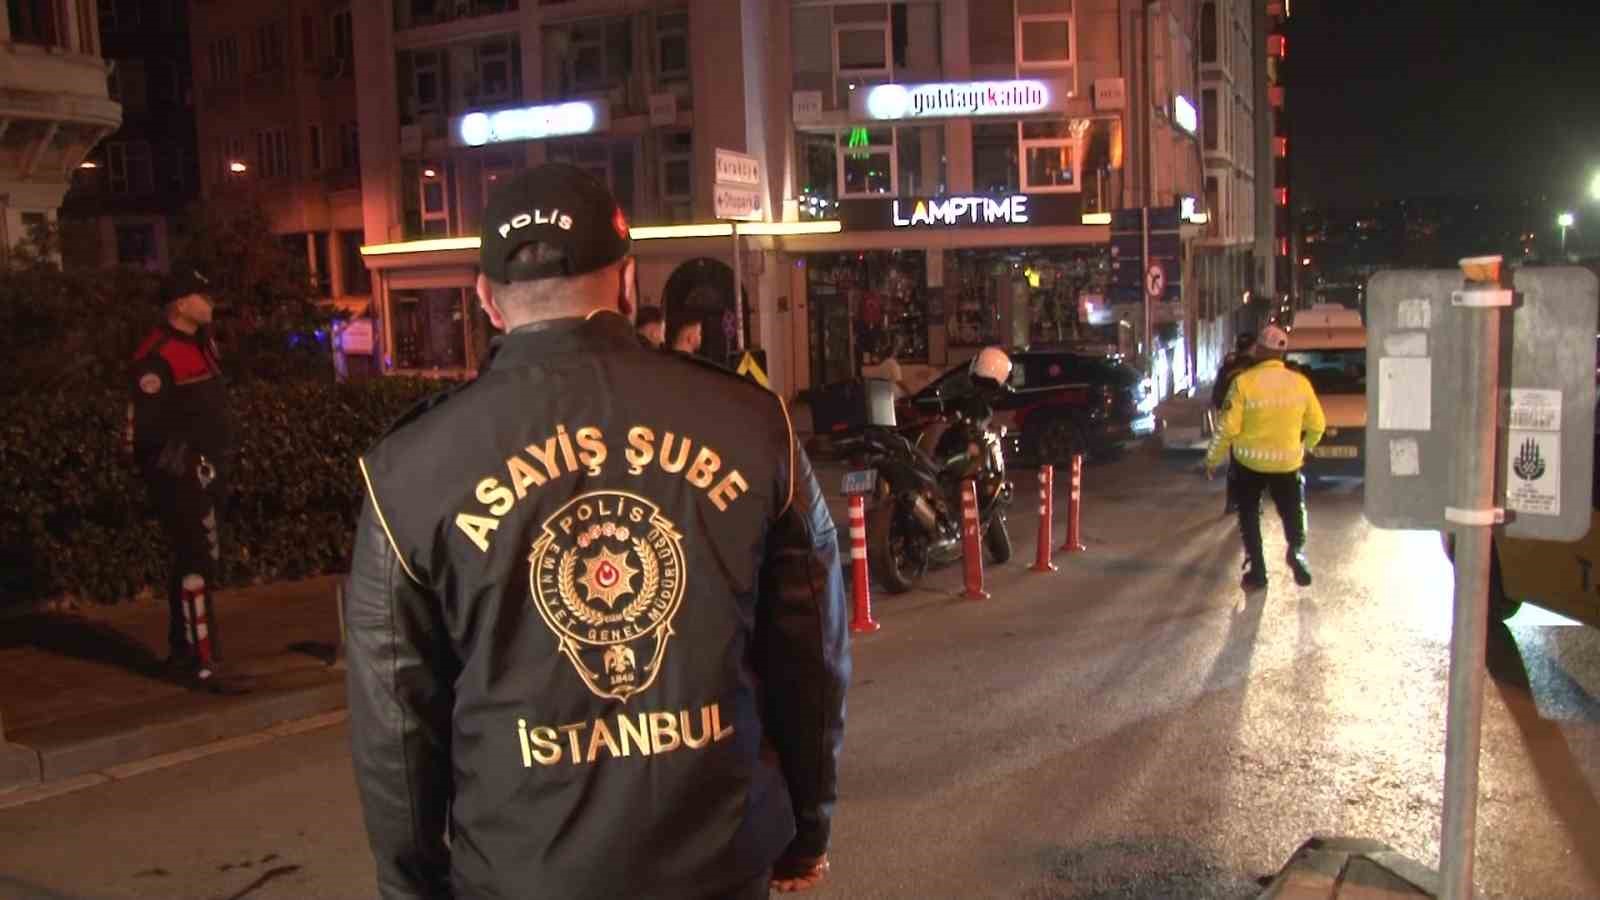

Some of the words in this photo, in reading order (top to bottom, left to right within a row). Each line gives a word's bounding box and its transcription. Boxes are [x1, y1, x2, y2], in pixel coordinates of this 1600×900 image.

[893, 195, 1028, 226] LAMPTIME
[455, 424, 607, 553] ASAYİŞ
[625, 426, 749, 512] ŞUBE
[559, 497, 645, 536] POLİS
[541, 543, 577, 630] EMNİYET
[588, 621, 644, 641] GENEL
[517, 703, 735, 768] İSTANBUL
